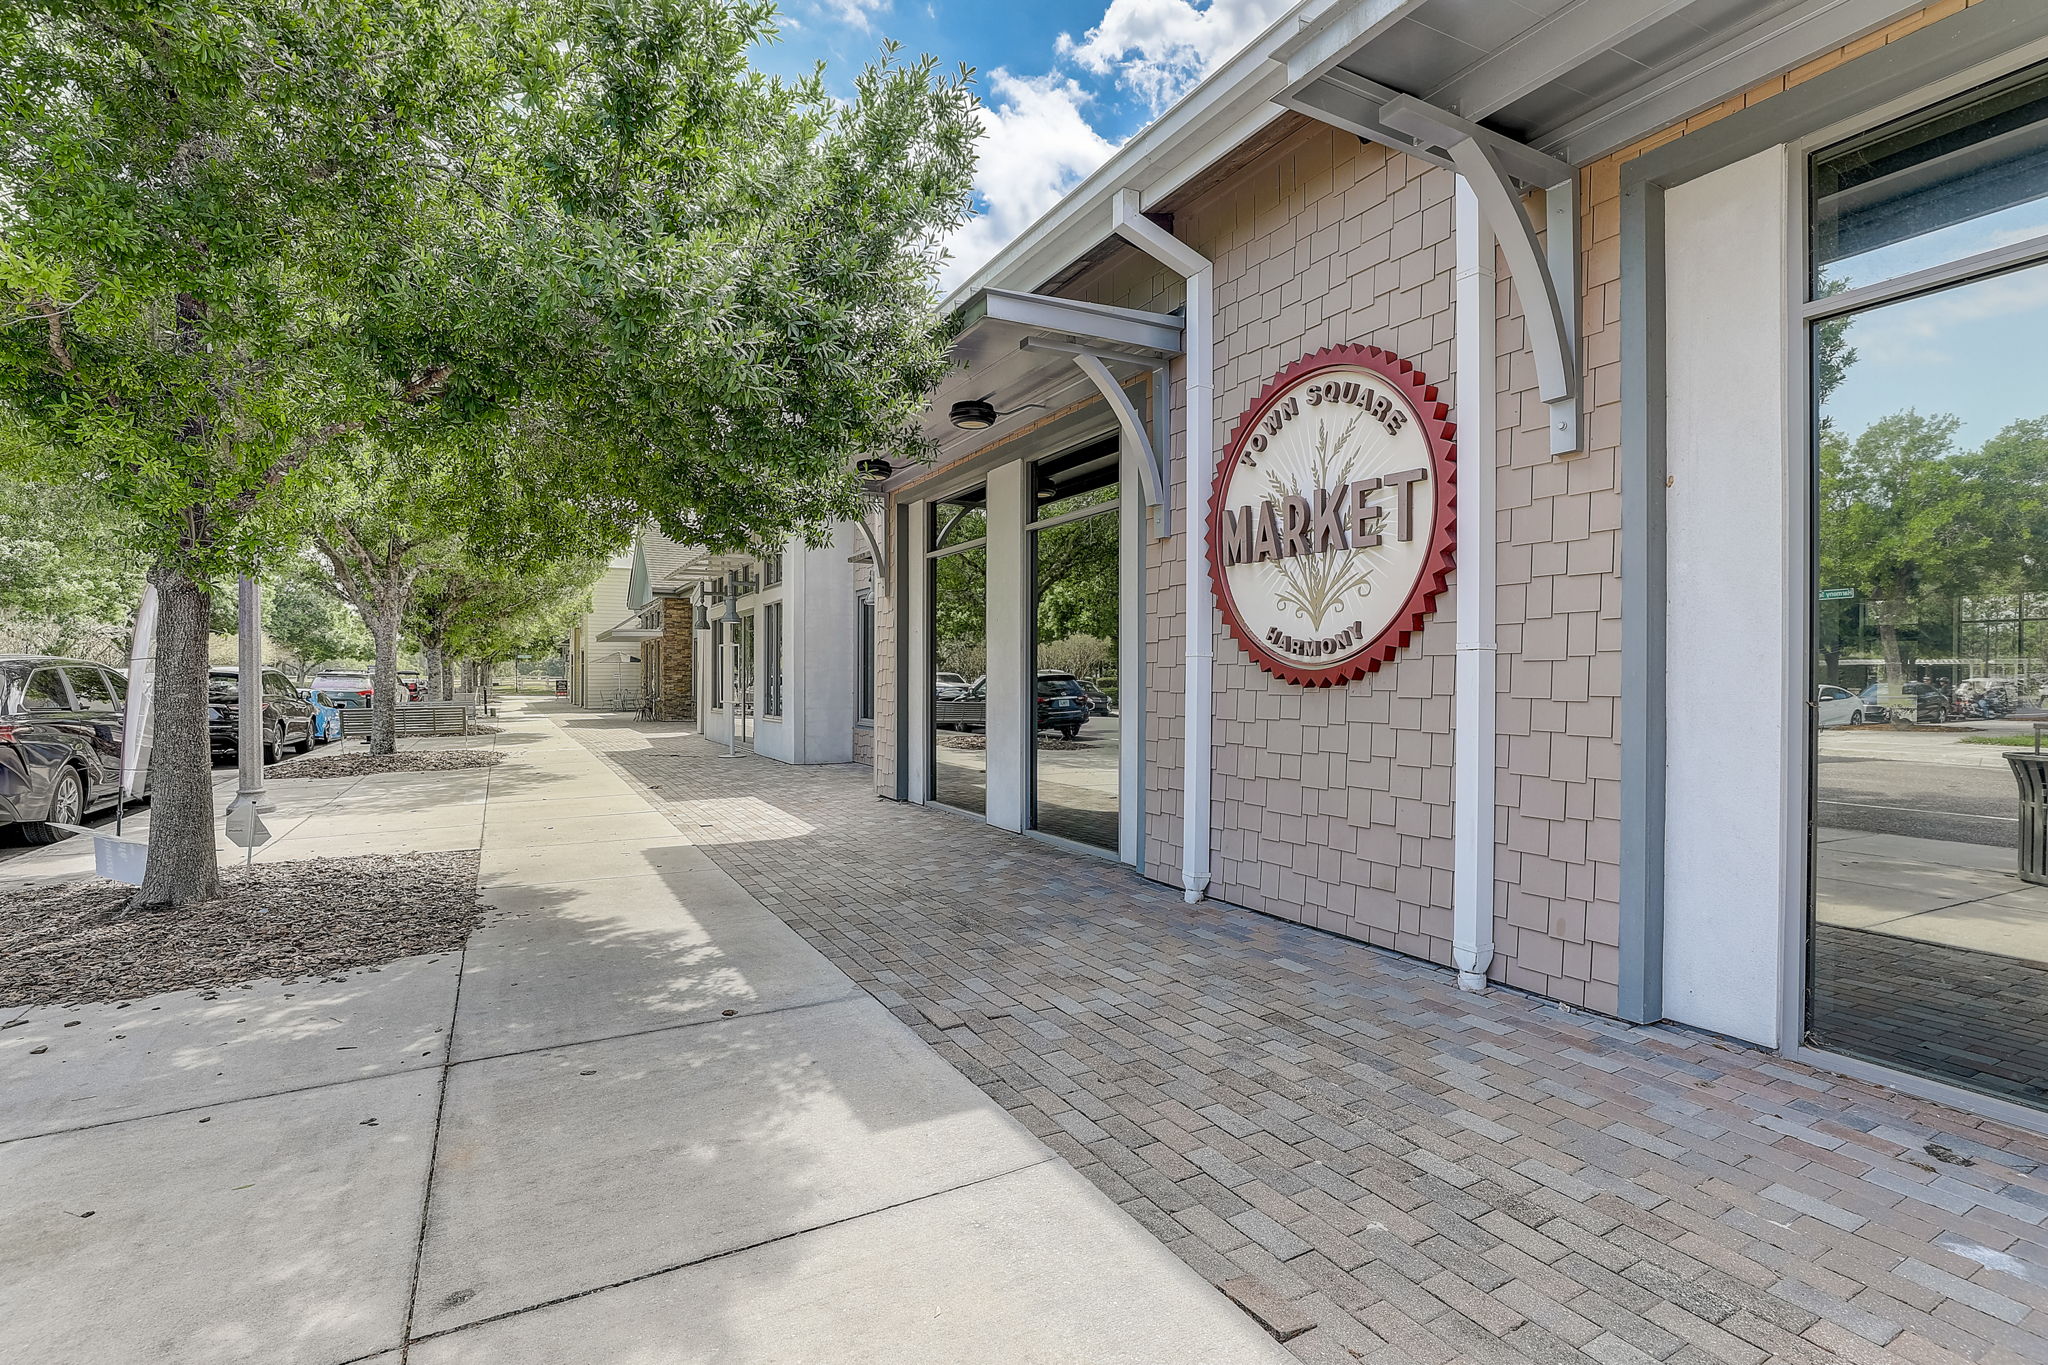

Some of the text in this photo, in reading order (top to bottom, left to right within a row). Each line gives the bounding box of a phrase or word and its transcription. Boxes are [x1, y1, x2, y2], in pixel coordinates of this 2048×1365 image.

[1240, 381, 1407, 467] TOWN SQUARE
[1222, 468, 1427, 566] MARKET
[1266, 620, 1363, 656] HARMONY
